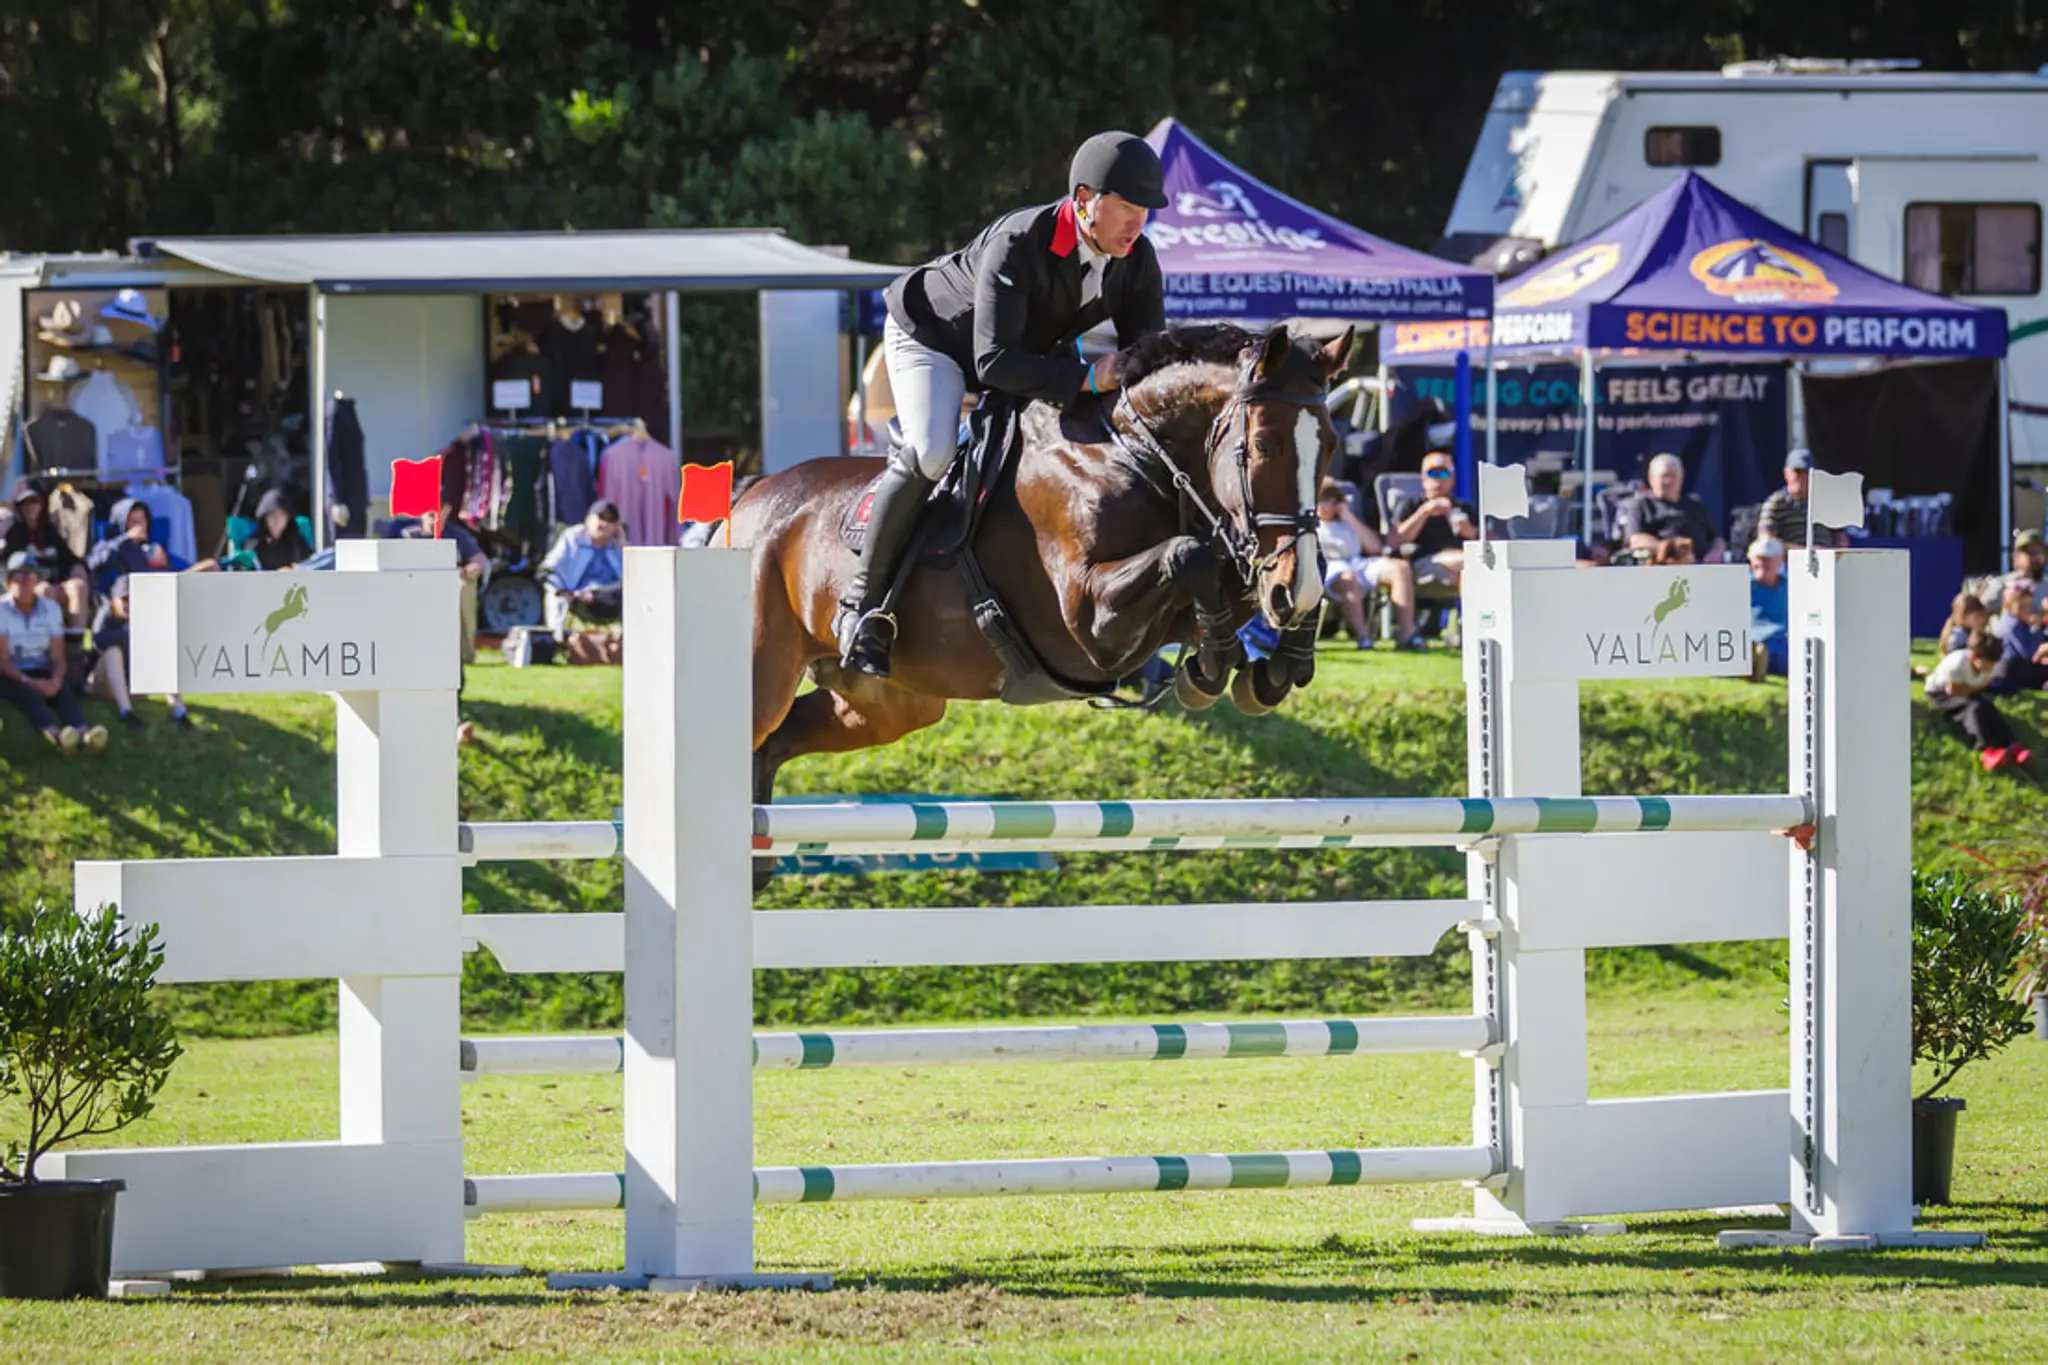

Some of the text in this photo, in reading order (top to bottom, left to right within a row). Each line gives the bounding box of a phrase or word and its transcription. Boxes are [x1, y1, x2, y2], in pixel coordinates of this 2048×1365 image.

[1163, 272, 1463, 296] TIGE EQUESTRIAN AUSTRALIA
[1626, 312, 1976, 349] SCIENCE TO PERFORM
[1608, 377, 1682, 404] FEELS
[1686, 373, 1768, 402] GREAT
[185, 641, 376, 678] YALAMBI
[1586, 629, 1747, 665] YALAMBI
